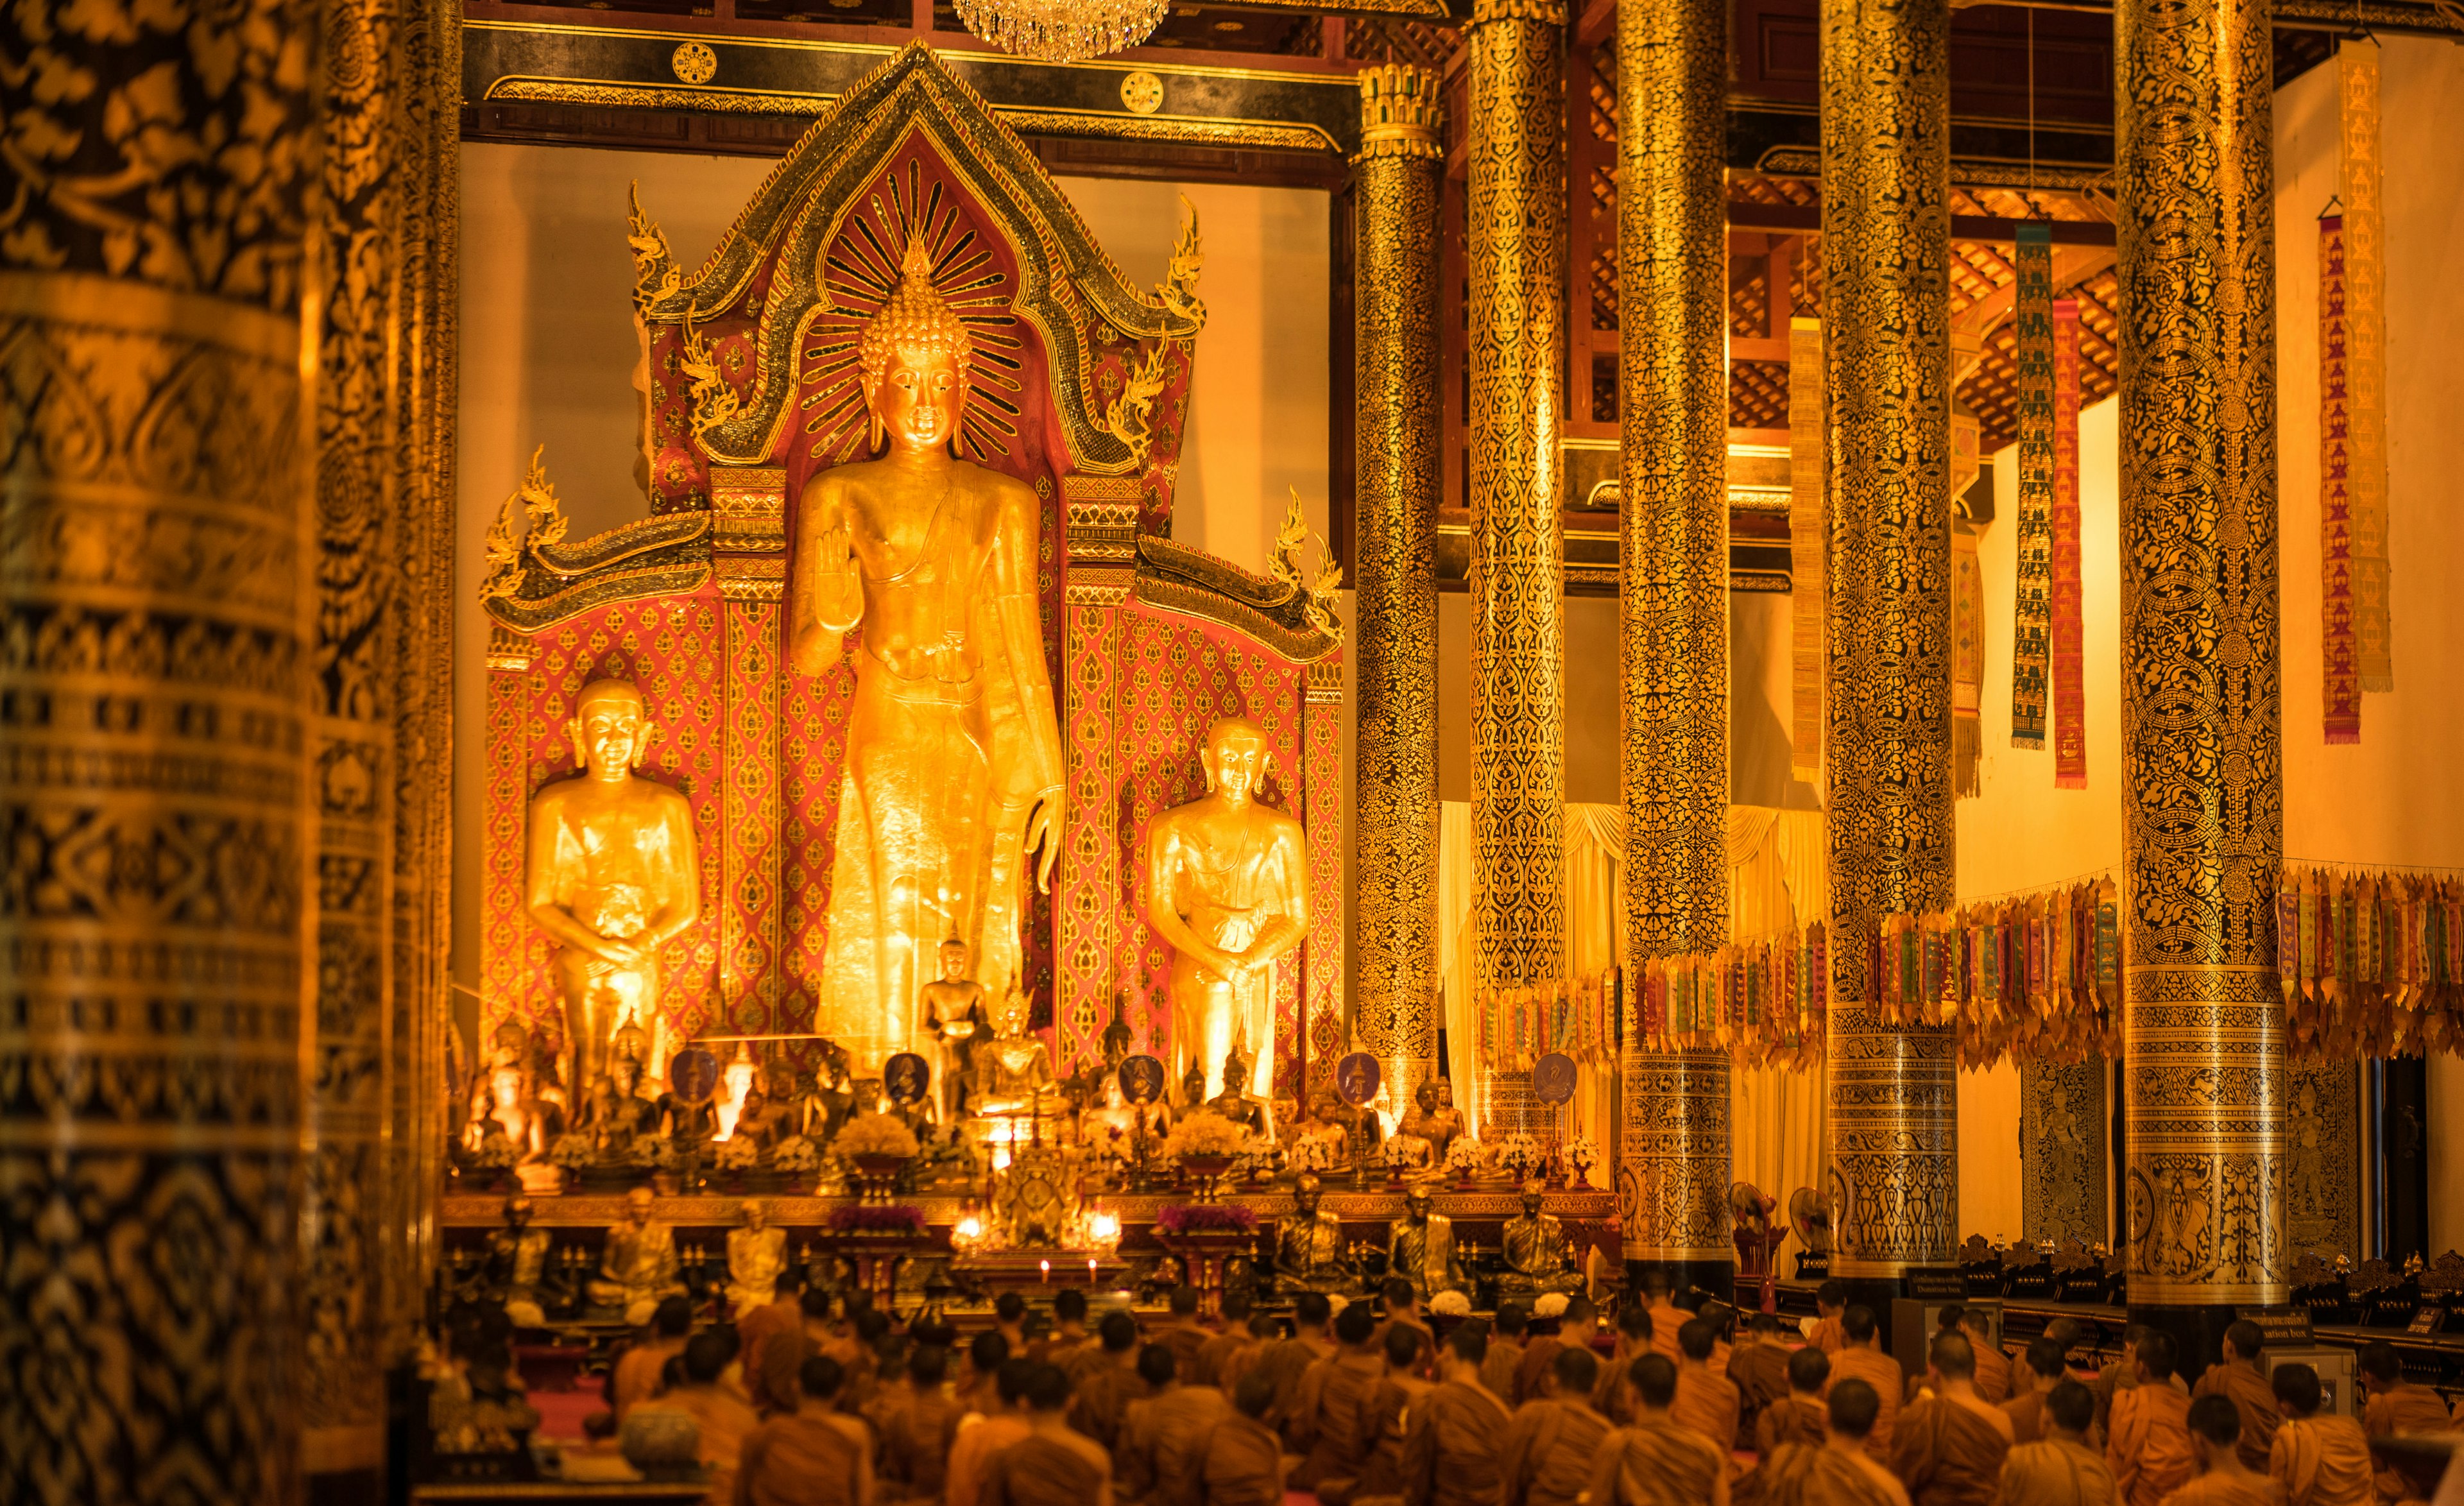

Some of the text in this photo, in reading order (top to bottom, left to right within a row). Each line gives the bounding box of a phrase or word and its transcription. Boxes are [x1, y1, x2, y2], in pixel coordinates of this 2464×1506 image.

[1917, 1285, 1962, 1294] Donation box
[2264, 1327, 2307, 1339] nation box
